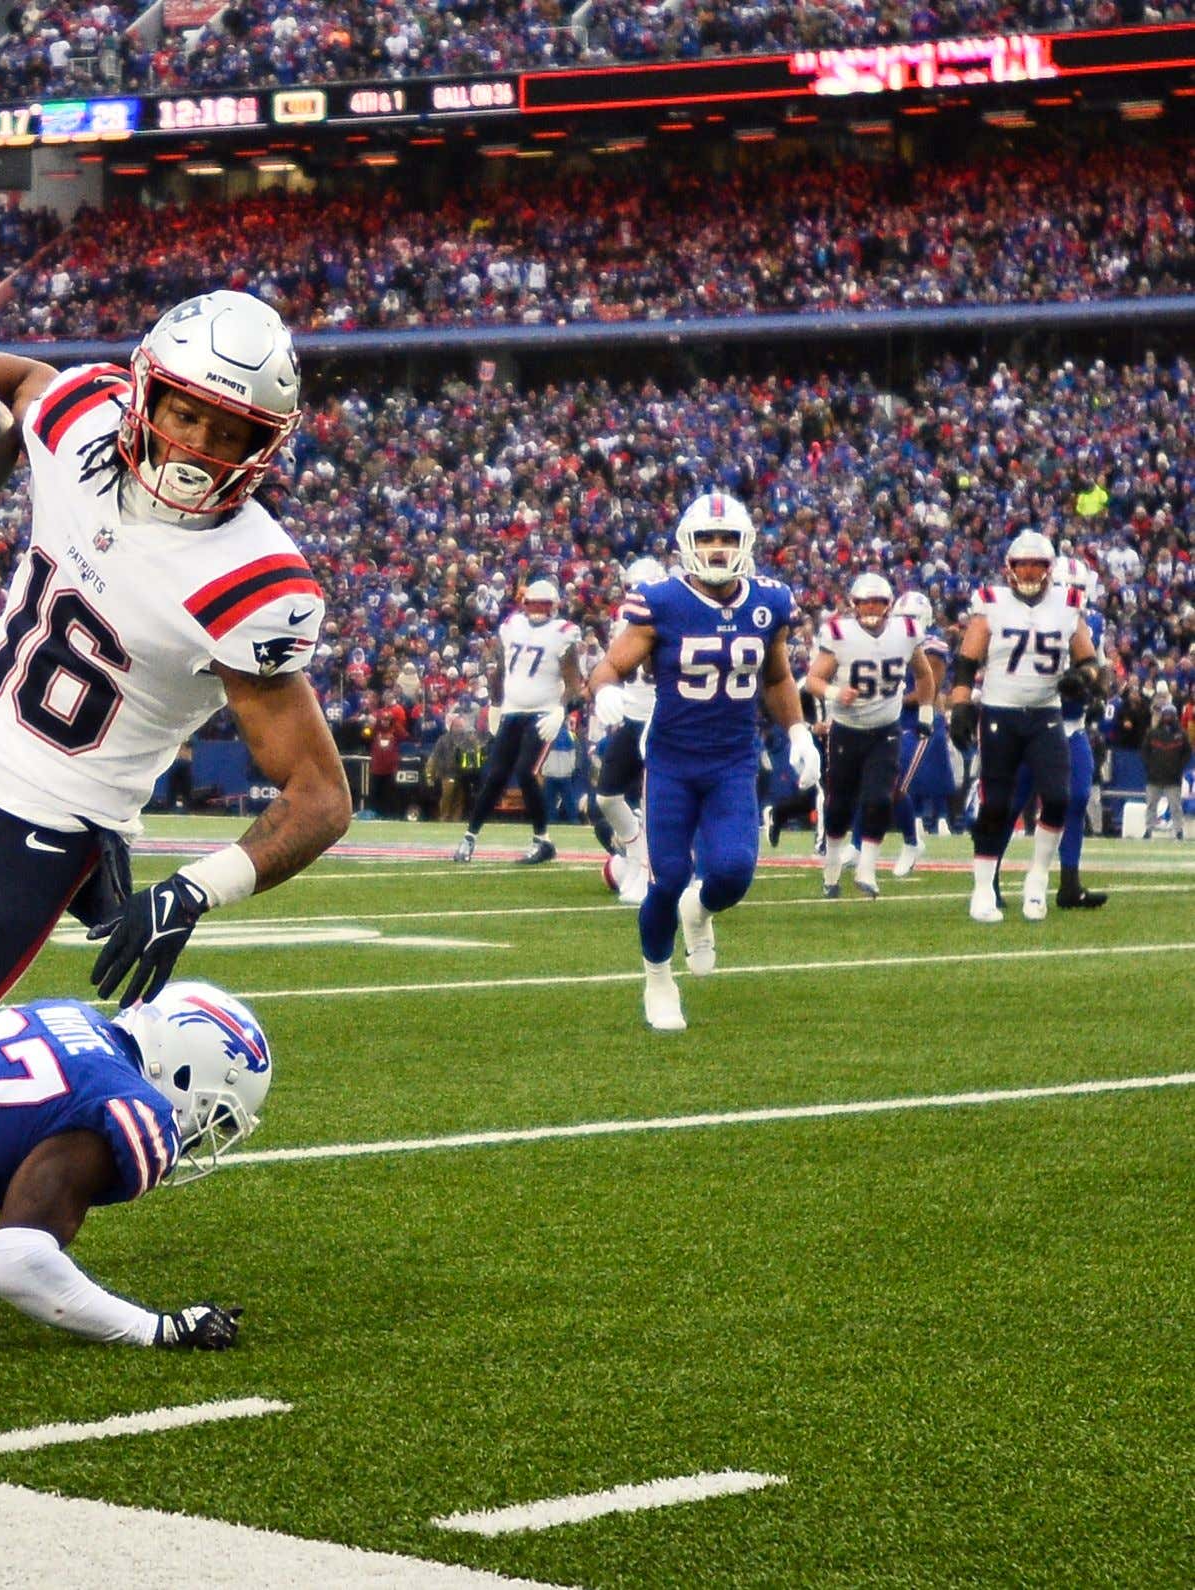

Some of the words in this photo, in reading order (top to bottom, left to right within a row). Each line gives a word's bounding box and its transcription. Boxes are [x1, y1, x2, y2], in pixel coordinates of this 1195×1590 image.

[206, 371, 247, 396] PATRIOTS
[67, 545, 106, 594] PATRIOTS
[757, 610, 767, 626] 3
[509, 642, 545, 678] 77
[677, 636, 765, 700] 58
[1001, 628, 1062, 675] 75
[849, 656, 905, 699] 65
[36, 1007, 116, 1057] WHITE
